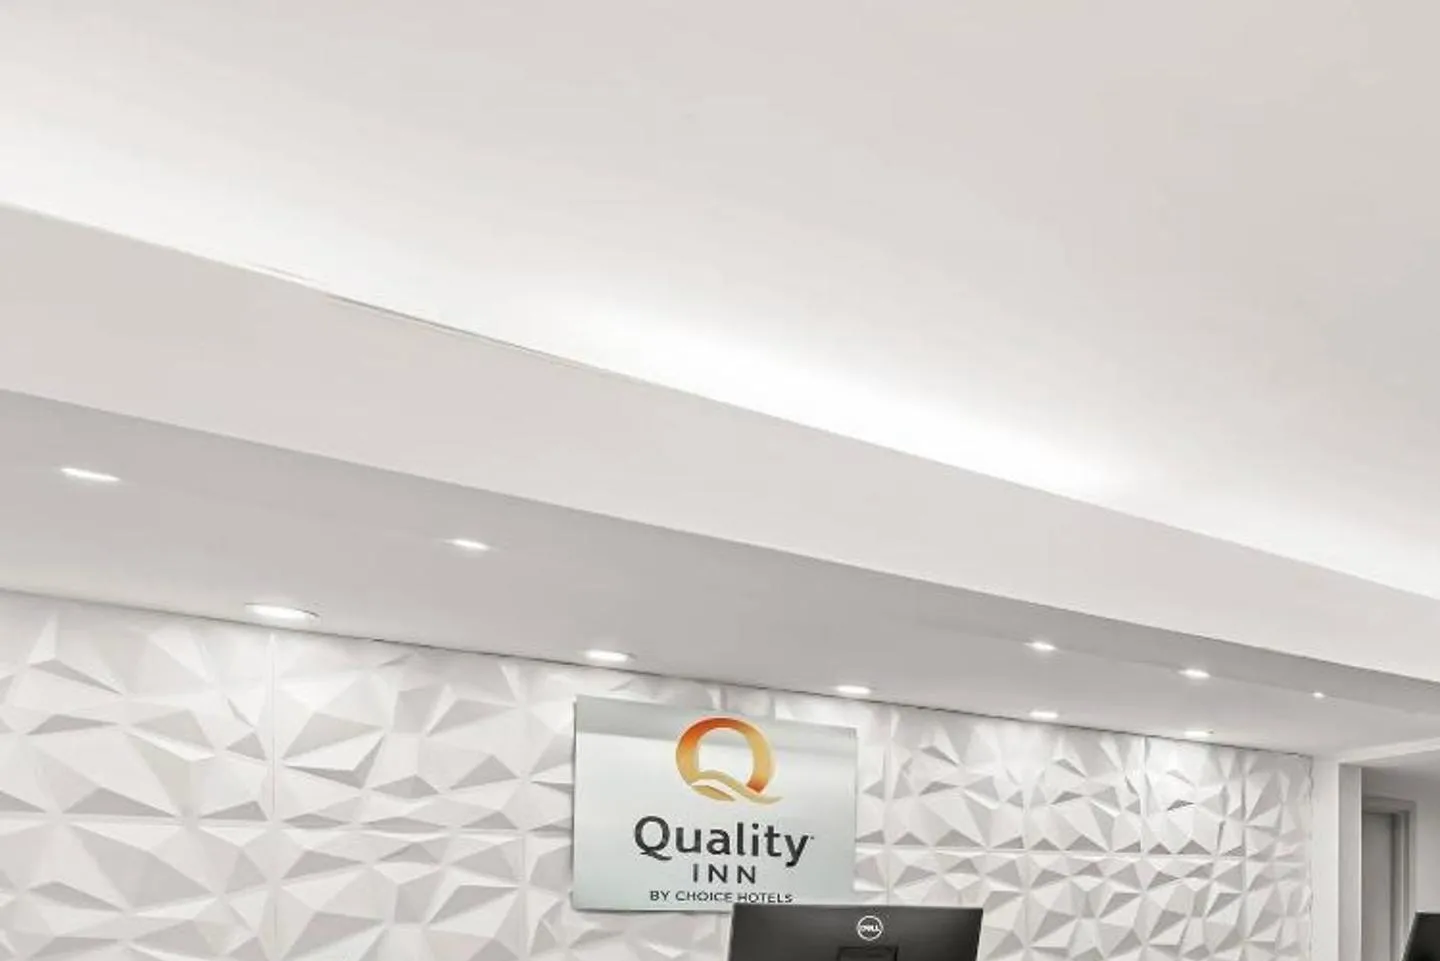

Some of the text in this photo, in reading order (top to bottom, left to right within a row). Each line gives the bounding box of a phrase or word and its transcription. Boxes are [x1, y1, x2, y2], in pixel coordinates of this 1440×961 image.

[634, 816, 810, 867] Quality
[692, 863, 756, 884] INN
[650, 890, 793, 904] BY CHOICE HOTELS
